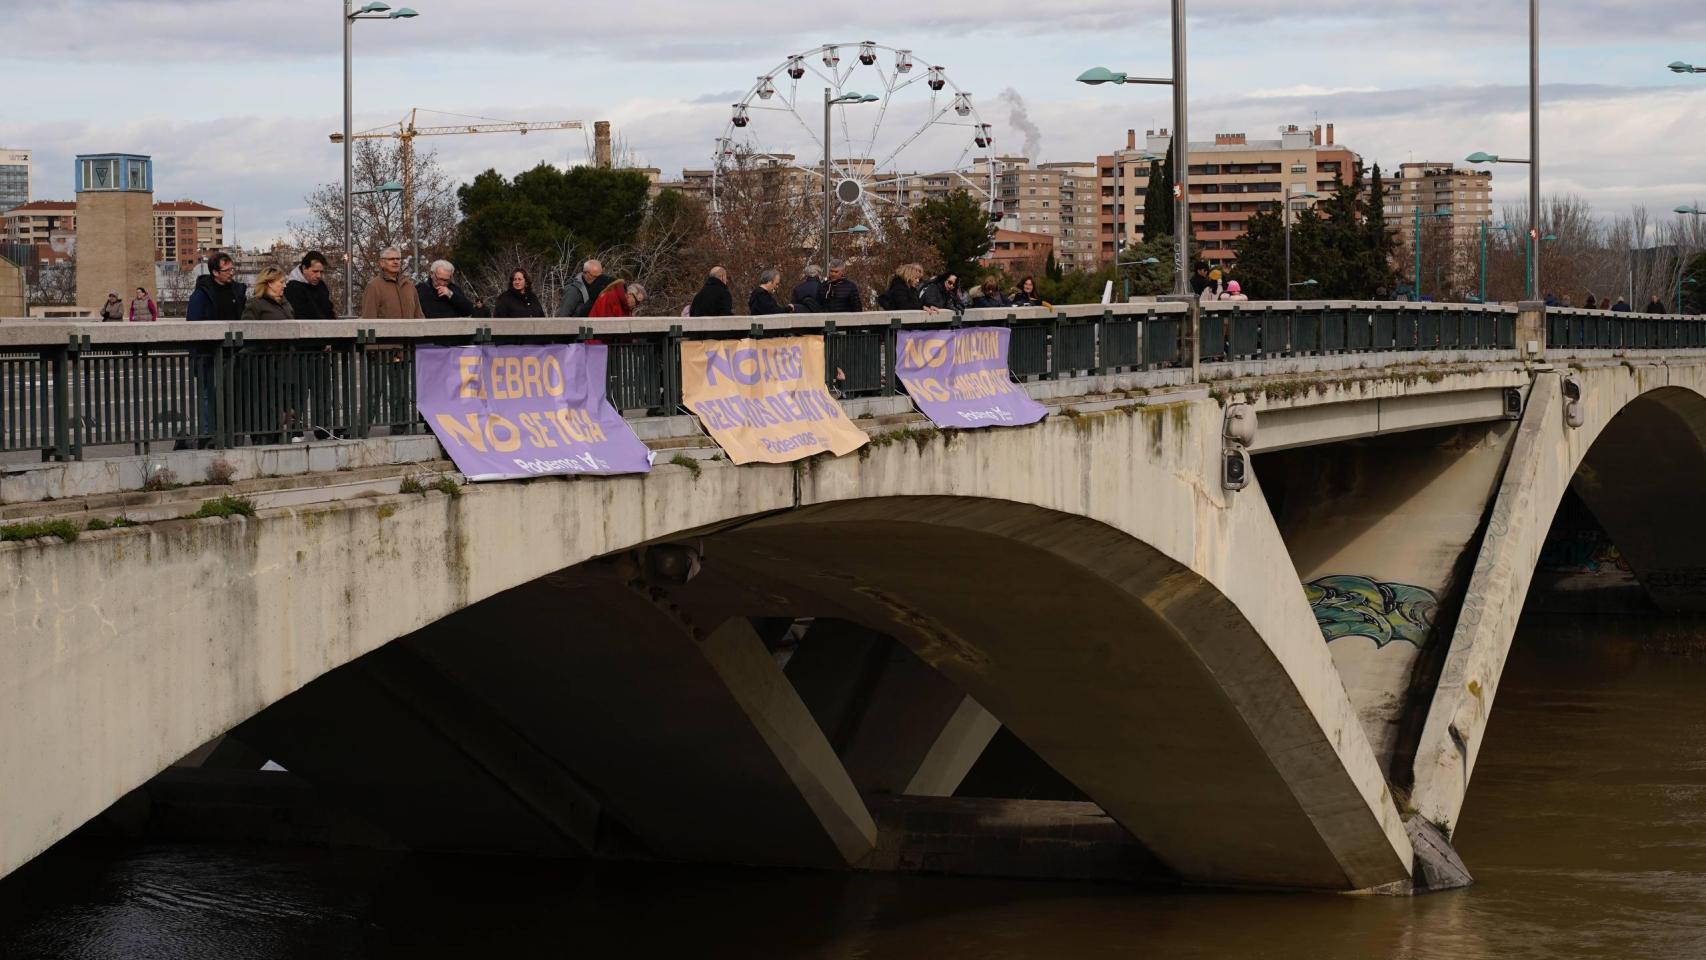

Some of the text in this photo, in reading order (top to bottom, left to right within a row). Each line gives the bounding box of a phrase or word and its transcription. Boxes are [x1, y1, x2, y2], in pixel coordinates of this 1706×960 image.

[705, 349, 761, 386] NO
[904, 338, 947, 369] NO
[490, 354, 564, 400] EBRO
[903, 377, 950, 402] NO
[436, 408, 608, 452] NO SE TOCA
